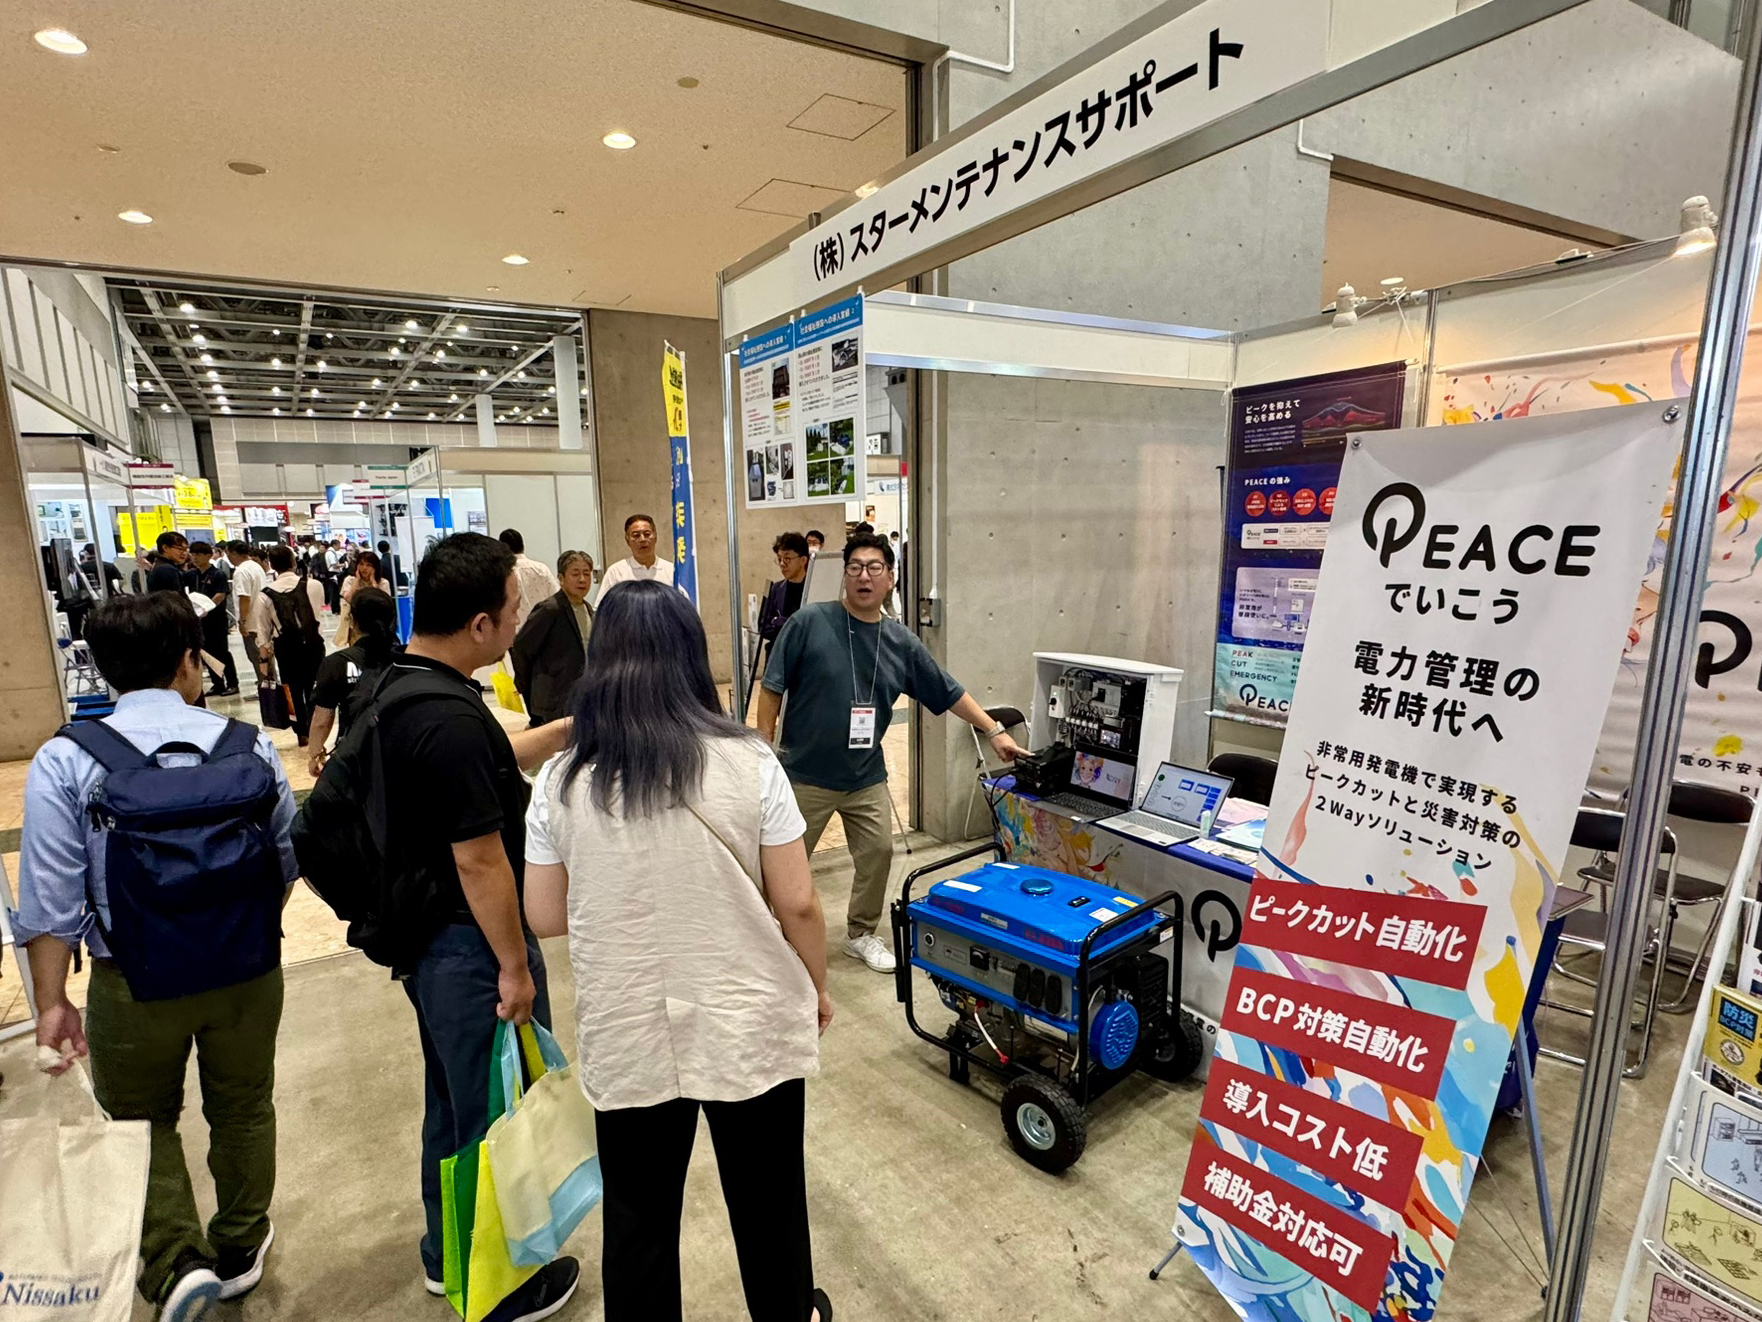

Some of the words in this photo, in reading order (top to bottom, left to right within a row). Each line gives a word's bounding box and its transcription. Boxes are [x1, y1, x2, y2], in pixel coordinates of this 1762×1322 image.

[850, 27, 1244, 262] スターメンテナンスサポート
[1245, 399, 1301, 414] ピークを抑えて
[1245, 411, 1292, 424] 安心を高める
[1244, 478, 1268, 486] PEACE
[1362, 482, 1601, 577] PEACE
[1385, 584, 1519, 625] でいこう
[1231, 660, 1248, 668] CUT
[1232, 650, 1254, 658] PEAK
[1354, 640, 1540, 702] 電力管理の
[1230, 670, 1278, 682] EMERGENCY
[1239, 683, 1292, 712] PEAC
[1359, 683, 1504, 743] 新時代へ
[1316, 740, 1518, 815] 非常用発電機で実現する
[1305, 764, 1521, 849] ピークカットと災害対策の
[1723, 1001, 1754, 1030] 防災
[1223, 1078, 1389, 1181] 導入コスト低
[1203, 1161, 1364, 1277] 補助金対応可
